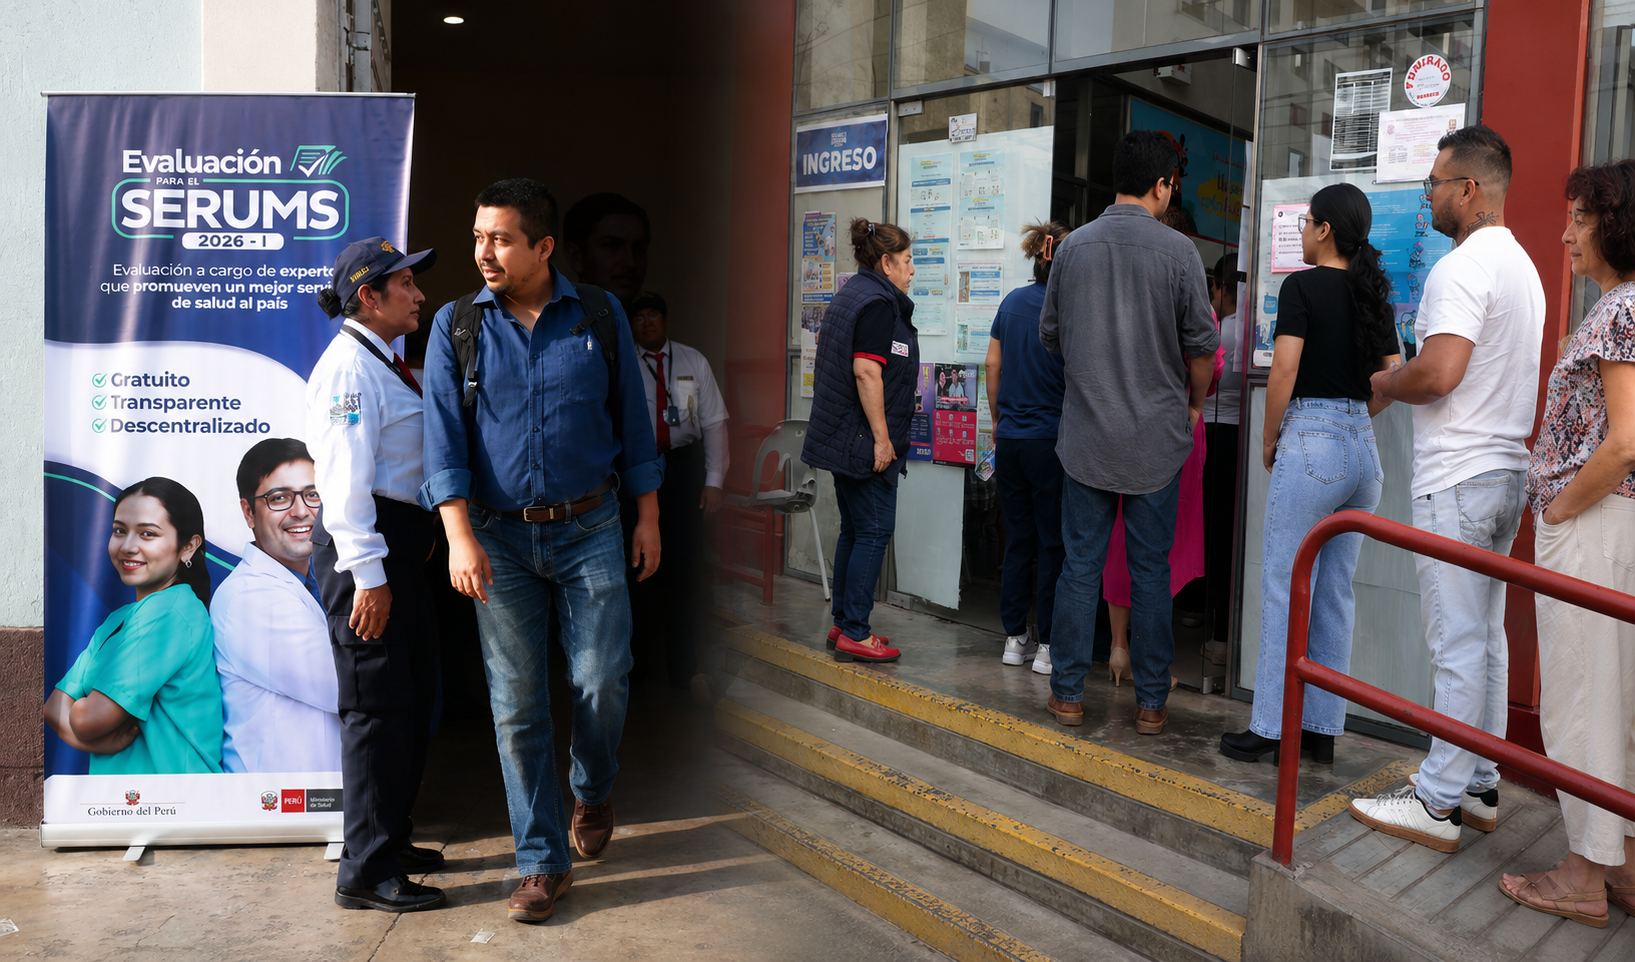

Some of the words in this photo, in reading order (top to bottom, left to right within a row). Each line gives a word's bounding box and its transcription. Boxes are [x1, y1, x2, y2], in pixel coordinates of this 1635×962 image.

[122, 148, 282, 174] Evaluación
[803, 146, 877, 175] INGRESO
[156, 177, 184, 185] PARA
[188, 177, 200, 185] EL
[121, 188, 340, 230] SERUMS
[198, 235, 244, 248] 2026
[113, 263, 193, 276] Evaluación
[196, 266, 205, 276] a
[209, 266, 252, 280] cargo
[257, 264, 276, 277] de
[279, 265, 334, 280] experto
[100, 281, 129, 294] que
[133, 282, 222, 294] promueven
[225, 282, 245, 293] un
[249, 280, 294, 296] mejor
[297, 280, 332, 294] servi
[171, 296, 191, 309] de
[194, 296, 236, 309] salud
[239, 296, 253, 309] al
[256, 296, 288, 312] país
[111, 371, 190, 388] Gratuito
[111, 395, 242, 413] Transparente
[111, 417, 271, 434] Descentralizado
[284, 795, 303, 804] PERÚ
[87, 806, 133, 816] Gobierno
[136, 806, 151, 816] del
[154, 806, 176, 816] Perú
